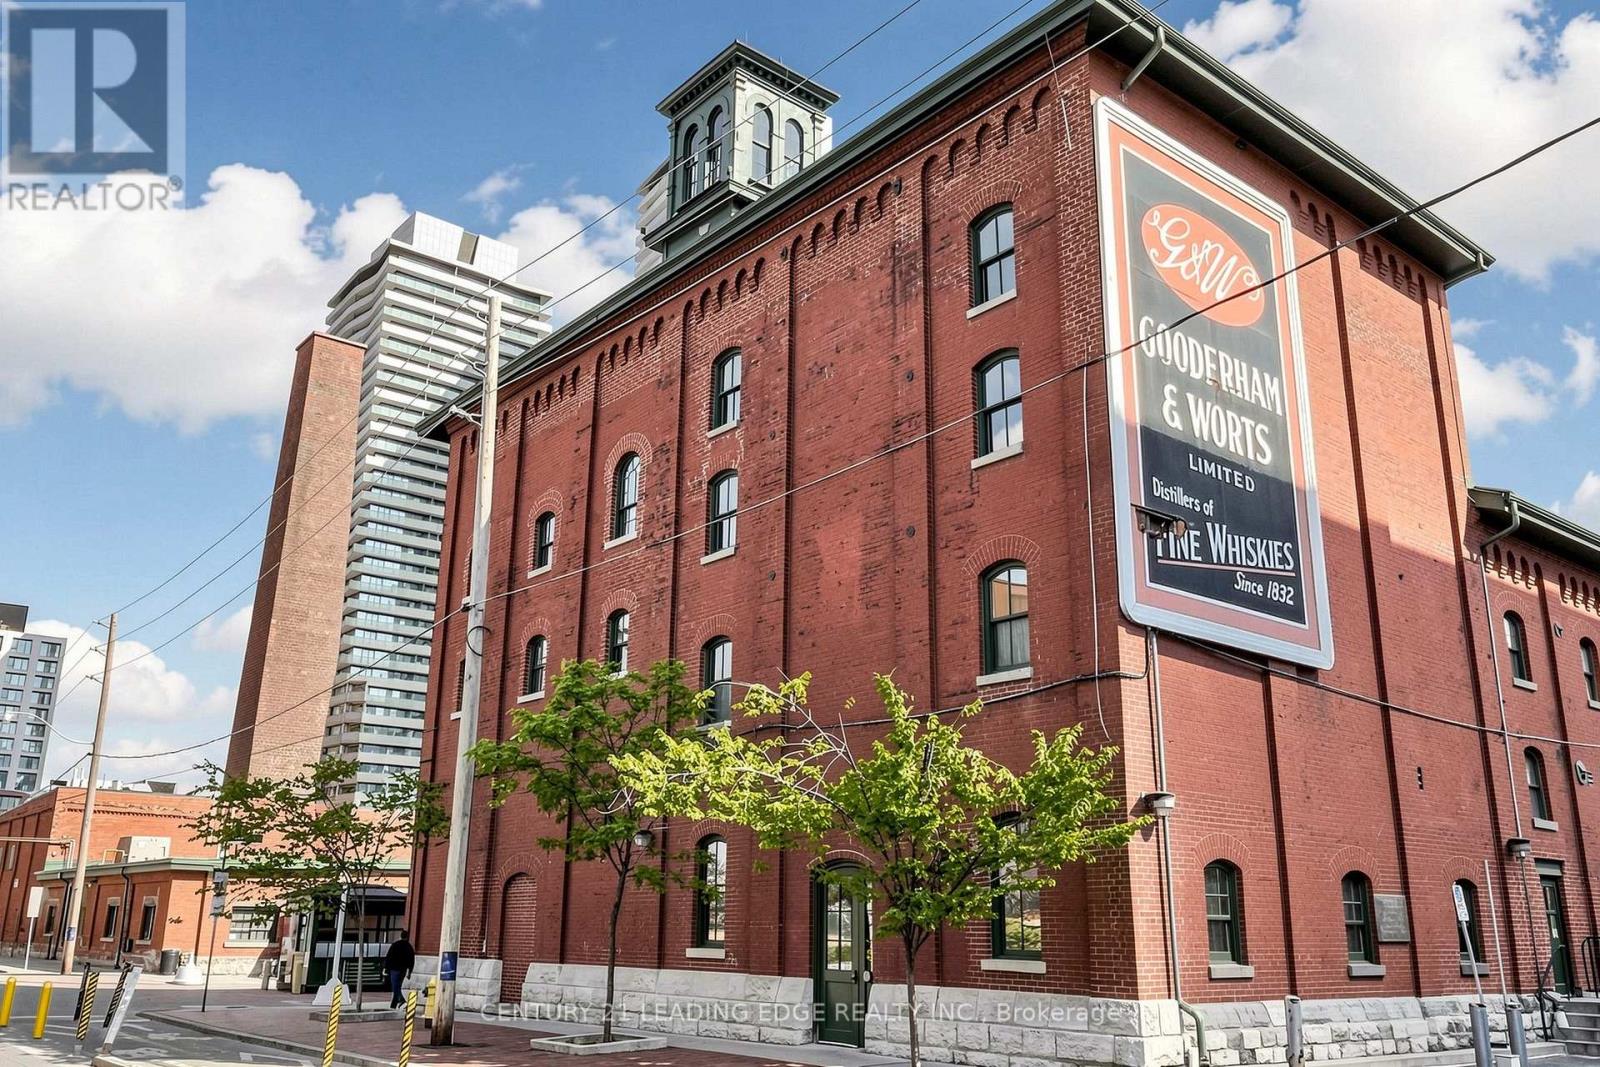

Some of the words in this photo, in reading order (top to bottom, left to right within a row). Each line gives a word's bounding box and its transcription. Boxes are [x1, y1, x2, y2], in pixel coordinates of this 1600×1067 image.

[1146, 209, 1261, 302] G&W
[1139, 315, 1283, 417] GOODERHAM
[1162, 383, 1184, 431] &
[1186, 392, 1273, 466] WORTS
[1152, 476, 1201, 513] Distillers
[1202, 498, 1215, 517] of
[1188, 453, 1256, 493] LIMITED
[1205, 521, 1295, 571] WHISKIES
[1234, 571, 1264, 597] Since
[1266, 580, 1295, 606] 1832
